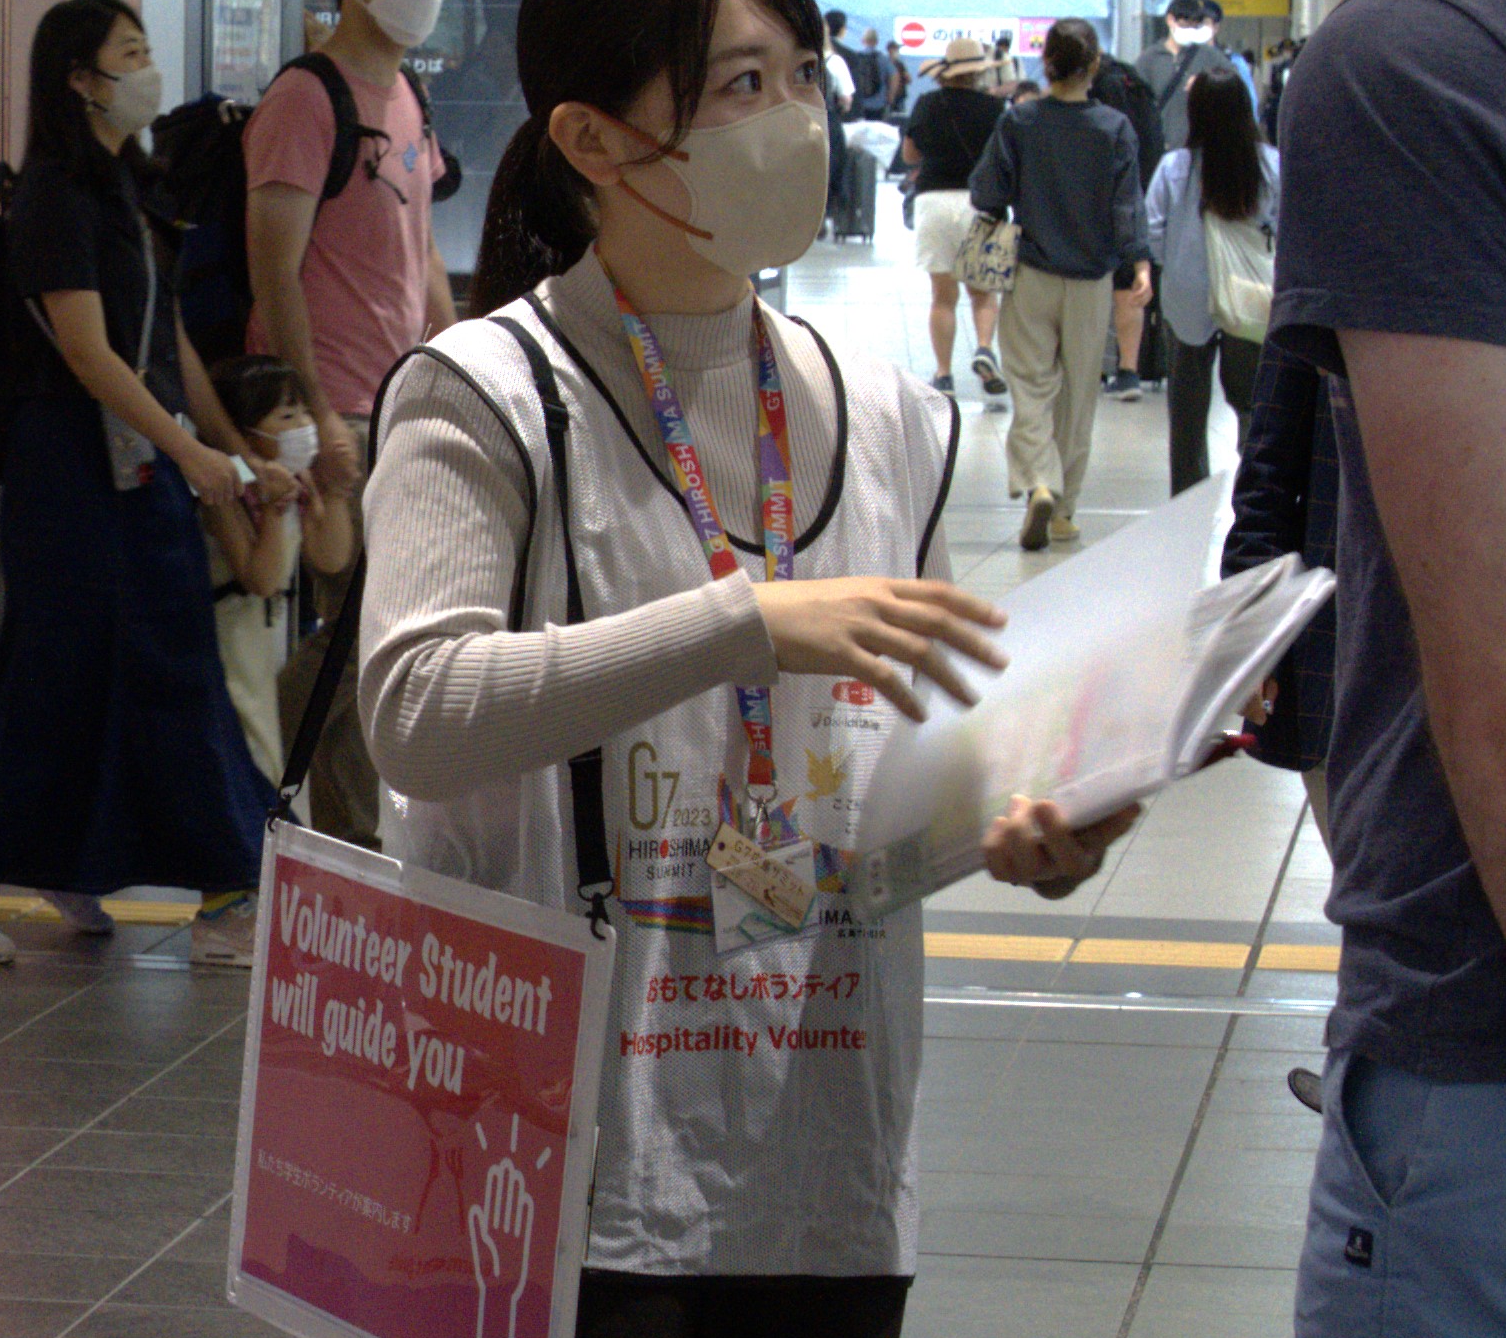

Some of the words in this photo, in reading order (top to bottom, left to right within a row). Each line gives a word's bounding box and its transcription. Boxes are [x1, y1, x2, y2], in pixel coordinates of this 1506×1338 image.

[635, 322, 674, 400] SUMMIT
[662, 406, 718, 527] HIROSHIMA
[772, 477, 788, 557] SUMMIT
[629, 741, 680, 830] G7
[672, 808, 711, 829] 2023
[647, 862, 695, 881] SUMMIT
[280, 882, 413, 988] Volunteer
[419, 932, 553, 1036] Student
[646, 972, 860, 1004] おもてなしボランティア
[272, 972, 315, 1041] will
[323, 990, 396, 1071] guide
[408, 1028, 466, 1095] you
[620, 1024, 758, 1059] Hospitality
